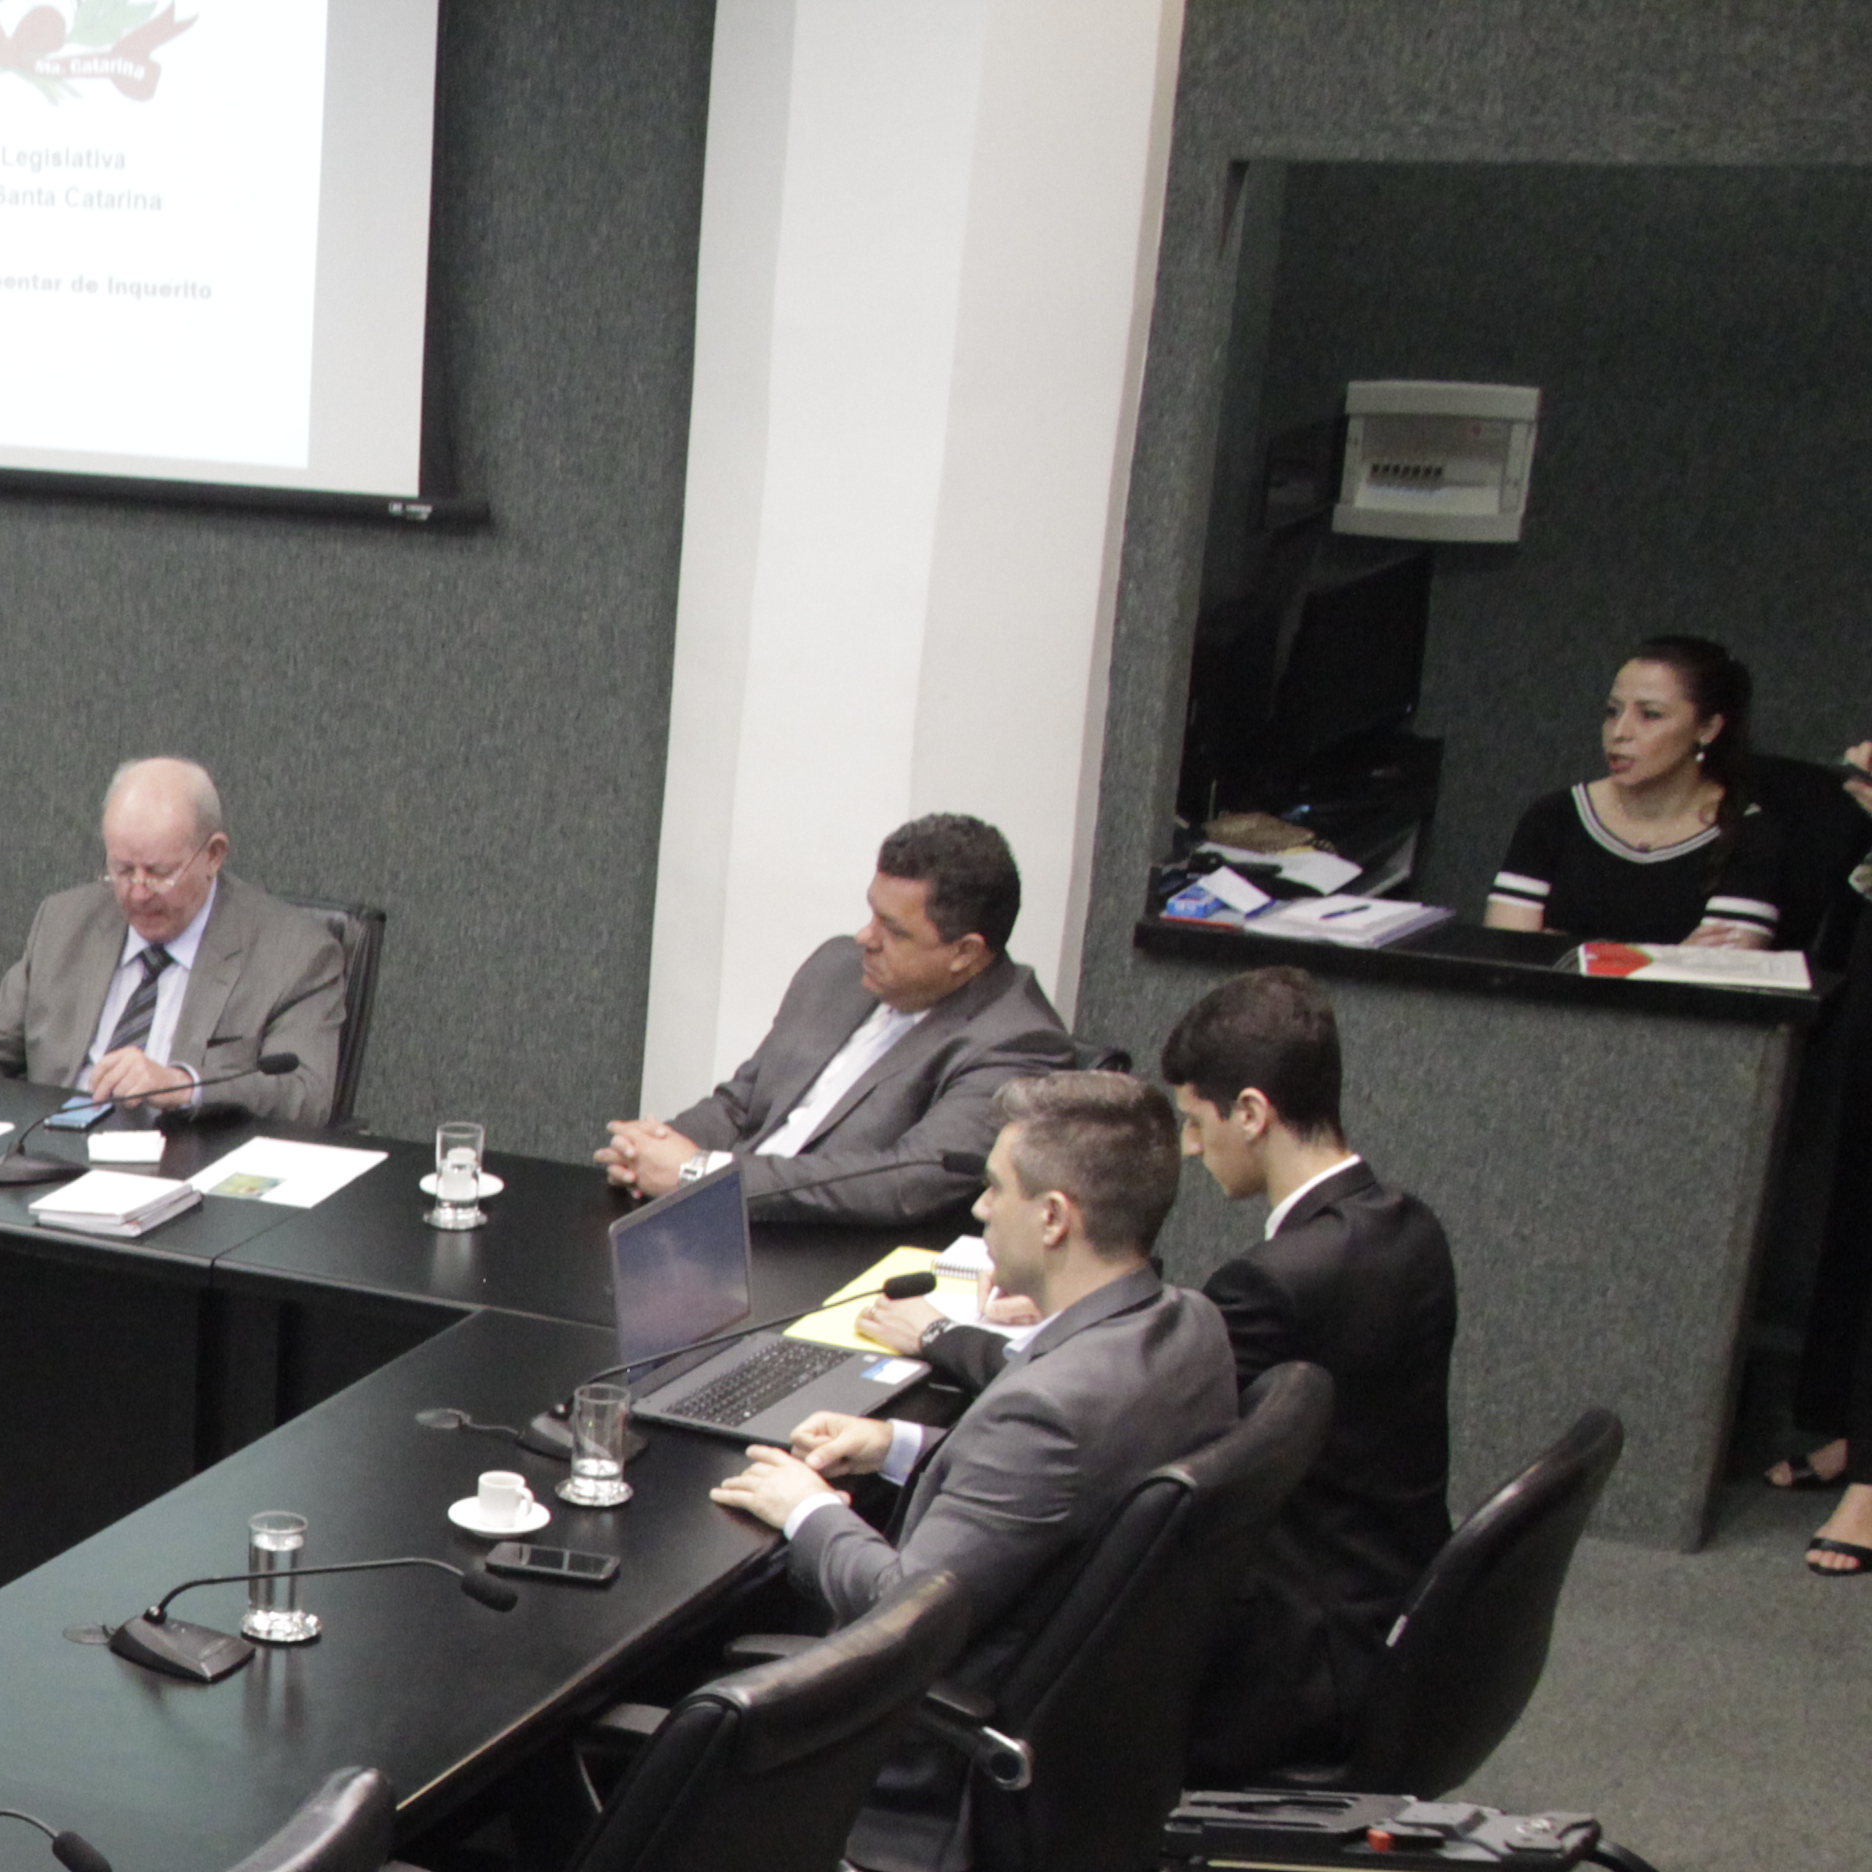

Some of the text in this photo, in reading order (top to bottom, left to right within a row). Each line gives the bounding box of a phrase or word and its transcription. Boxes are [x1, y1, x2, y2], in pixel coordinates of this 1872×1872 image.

[0, 144, 127, 174] Legislativa
[63, 186, 162, 212] Catarina
[69, 274, 99, 296] de
[107, 275, 213, 301] Inquérito
